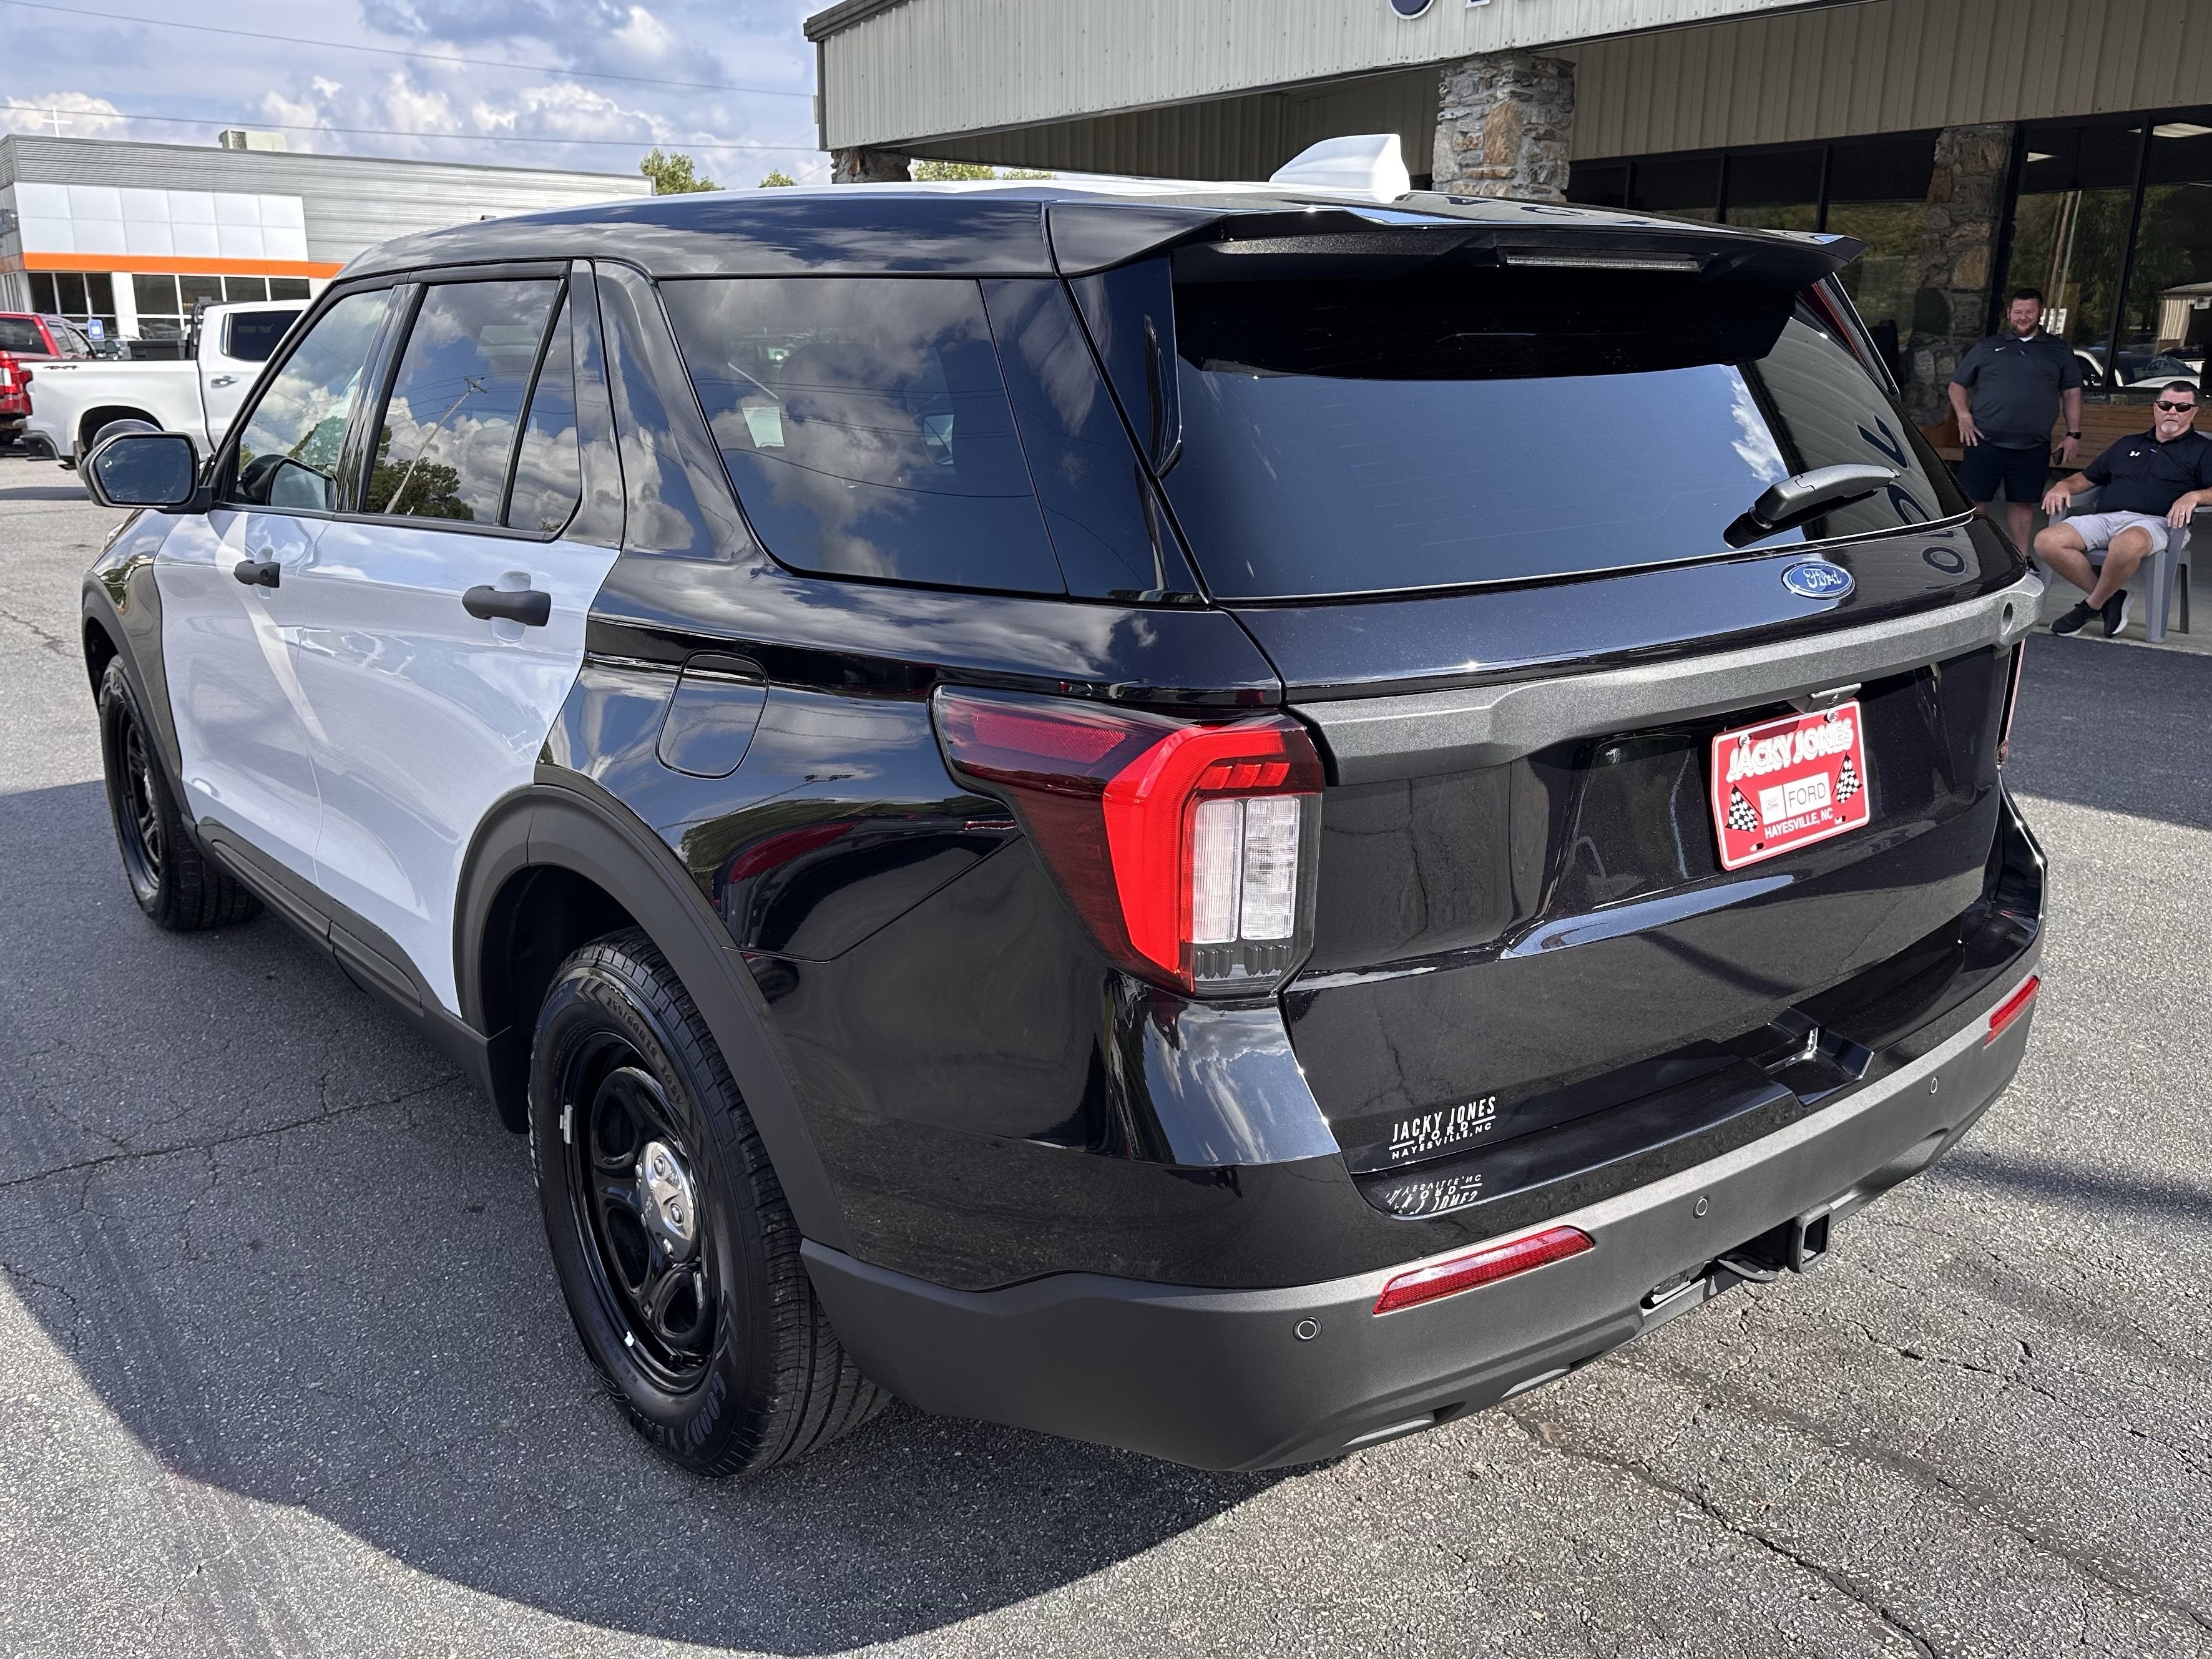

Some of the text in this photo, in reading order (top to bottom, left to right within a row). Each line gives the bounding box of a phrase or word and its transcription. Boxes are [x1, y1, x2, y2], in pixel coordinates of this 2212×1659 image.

[1803, 567, 1842, 589] Ford
[1726, 717, 1854, 783] JACKY JONES
[1788, 782, 1826, 809] FORD
[1764, 807, 1833, 839] HAYESVILLE, NC
[1392, 1096, 1496, 1142] JACKY JONES
[1418, 1121, 1469, 1144] FORD
